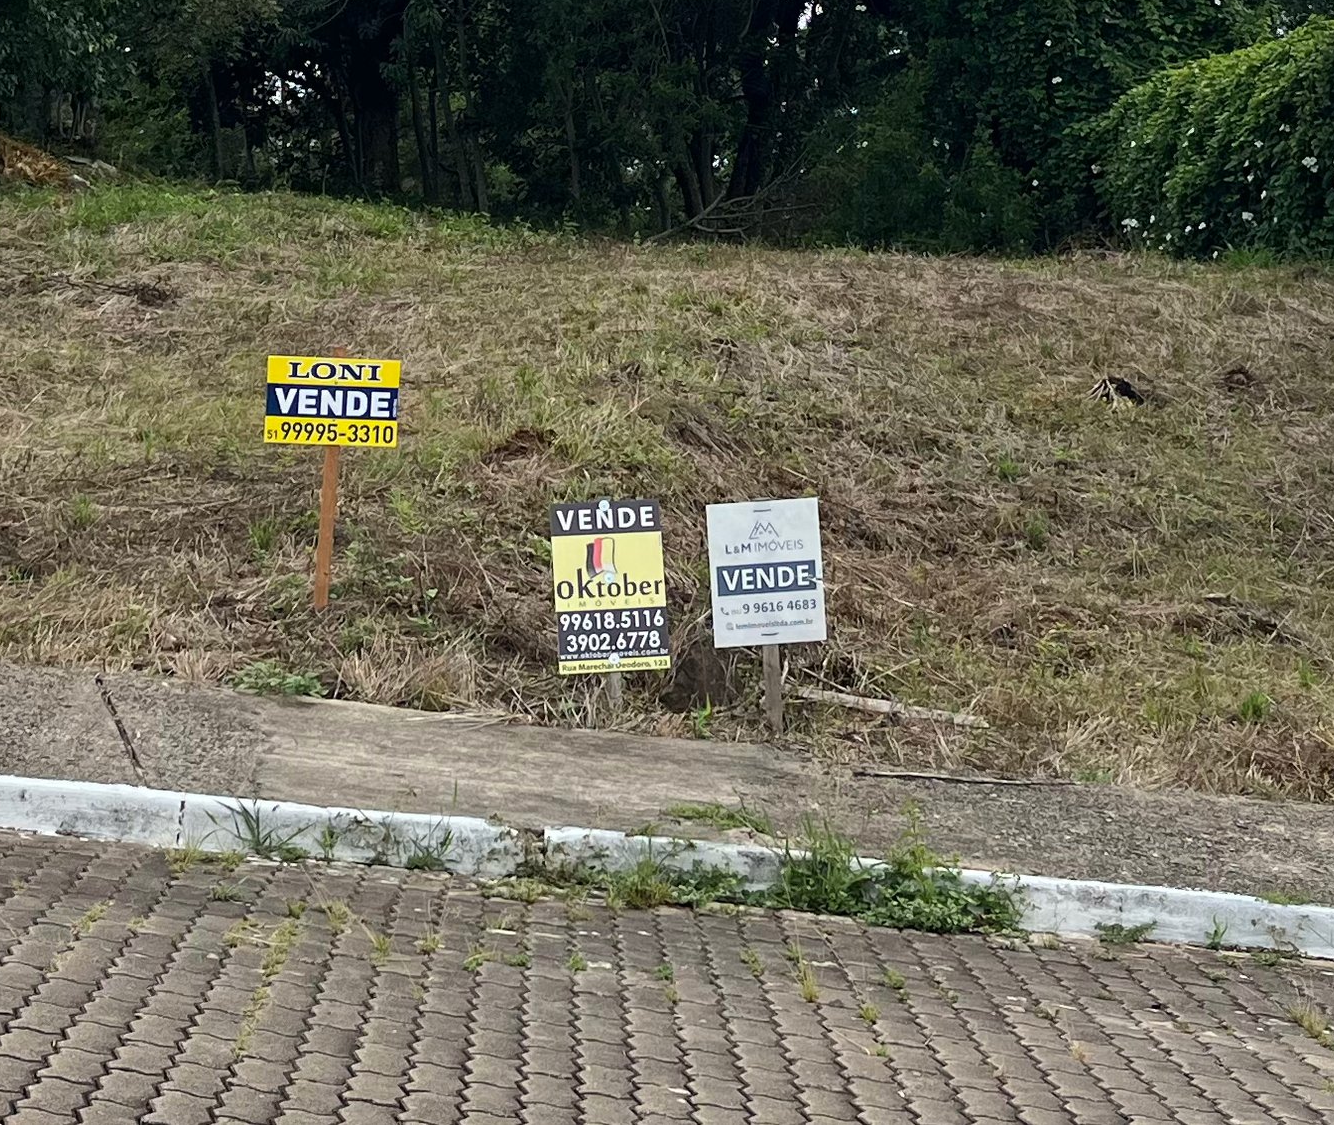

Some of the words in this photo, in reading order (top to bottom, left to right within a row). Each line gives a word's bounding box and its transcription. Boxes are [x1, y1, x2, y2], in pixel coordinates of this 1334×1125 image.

[288, 362, 381, 381] LONI
[274, 387, 391, 418] VENDE
[267, 429, 278, 439] 51
[280, 422, 394, 443] 99995-3310
[556, 506, 655, 531] VENDE
[754, 539, 804, 552] IMÓVEIS
[722, 565, 810, 591] VENDE
[742, 603, 750, 614] 9
[754, 601, 783, 613] 9616
[786, 599, 816, 611] 4683
[559, 609, 664, 631] 99618.5116
[566, 630, 661, 652] 3902.6778
[562, 664, 576, 672] Rua
[654, 659, 668, 667] 123
